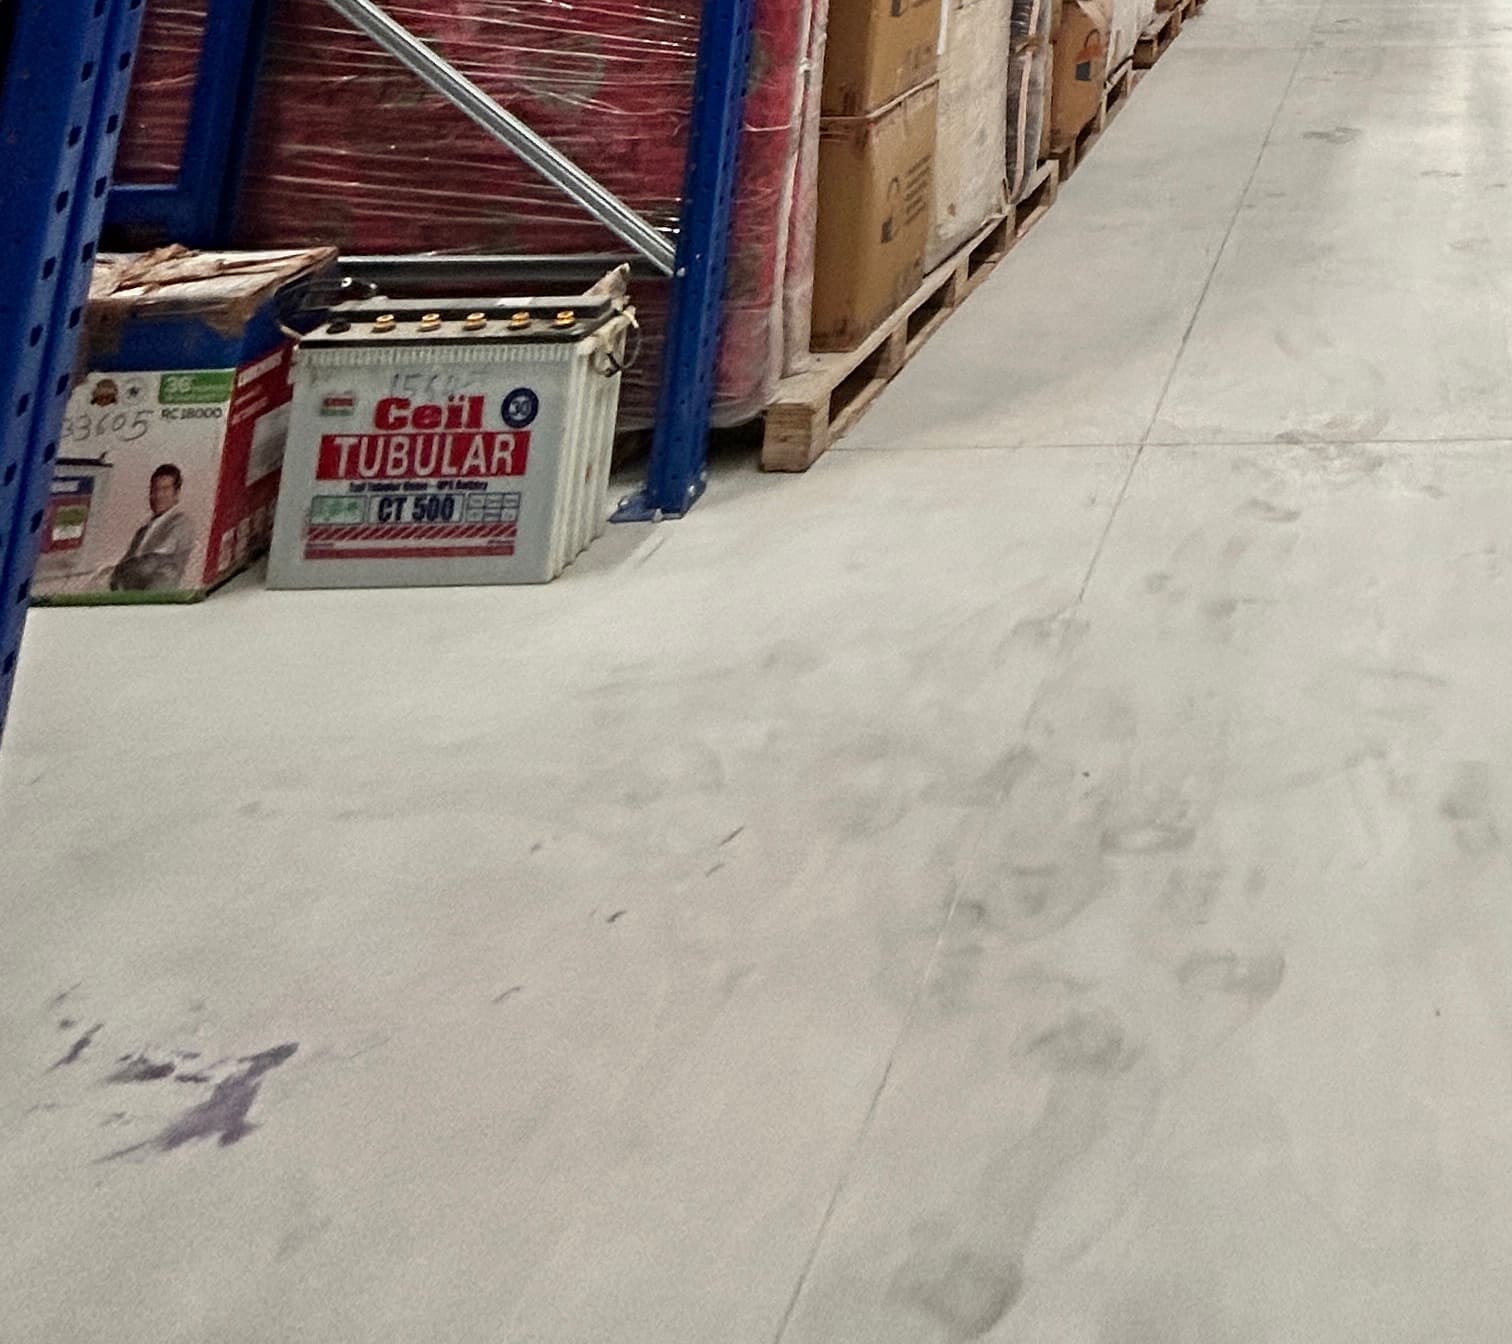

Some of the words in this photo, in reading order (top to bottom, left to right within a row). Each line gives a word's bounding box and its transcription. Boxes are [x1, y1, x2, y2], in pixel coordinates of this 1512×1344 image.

[333, 432, 516, 479] TUBULAR
[378, 496, 406, 523] CT
[412, 495, 455, 522] 500
